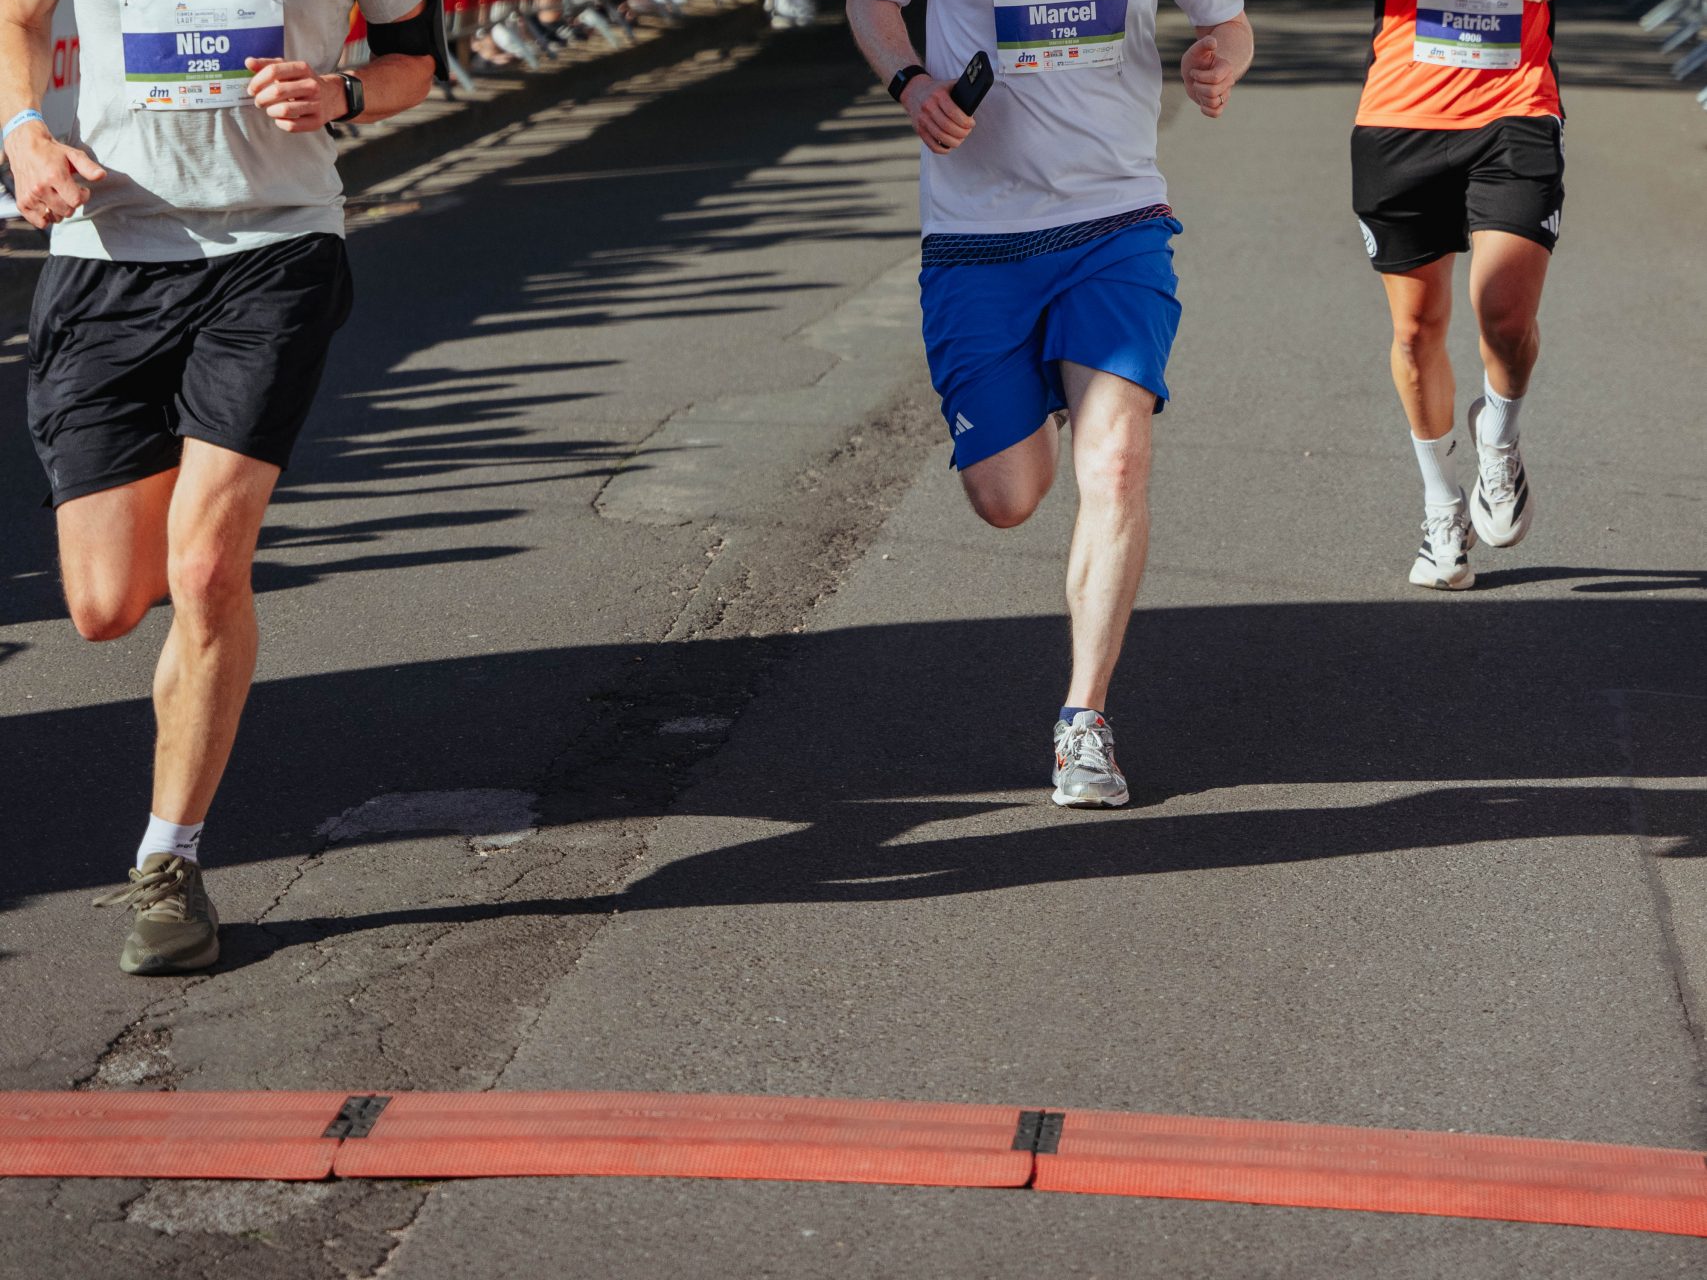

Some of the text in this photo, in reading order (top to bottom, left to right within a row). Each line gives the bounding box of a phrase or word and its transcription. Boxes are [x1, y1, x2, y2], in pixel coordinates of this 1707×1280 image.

[1029, 1, 1097, 26] Marcel
[1441, 11, 1501, 32] Patrick
[1050, 27, 1078, 39] 1794
[176, 32, 230, 56] Nico
[1018, 51, 1036, 63] dm
[1431, 47, 1445, 56] dm
[187, 59, 221, 73] 2295
[149, 85, 170, 98] dm
